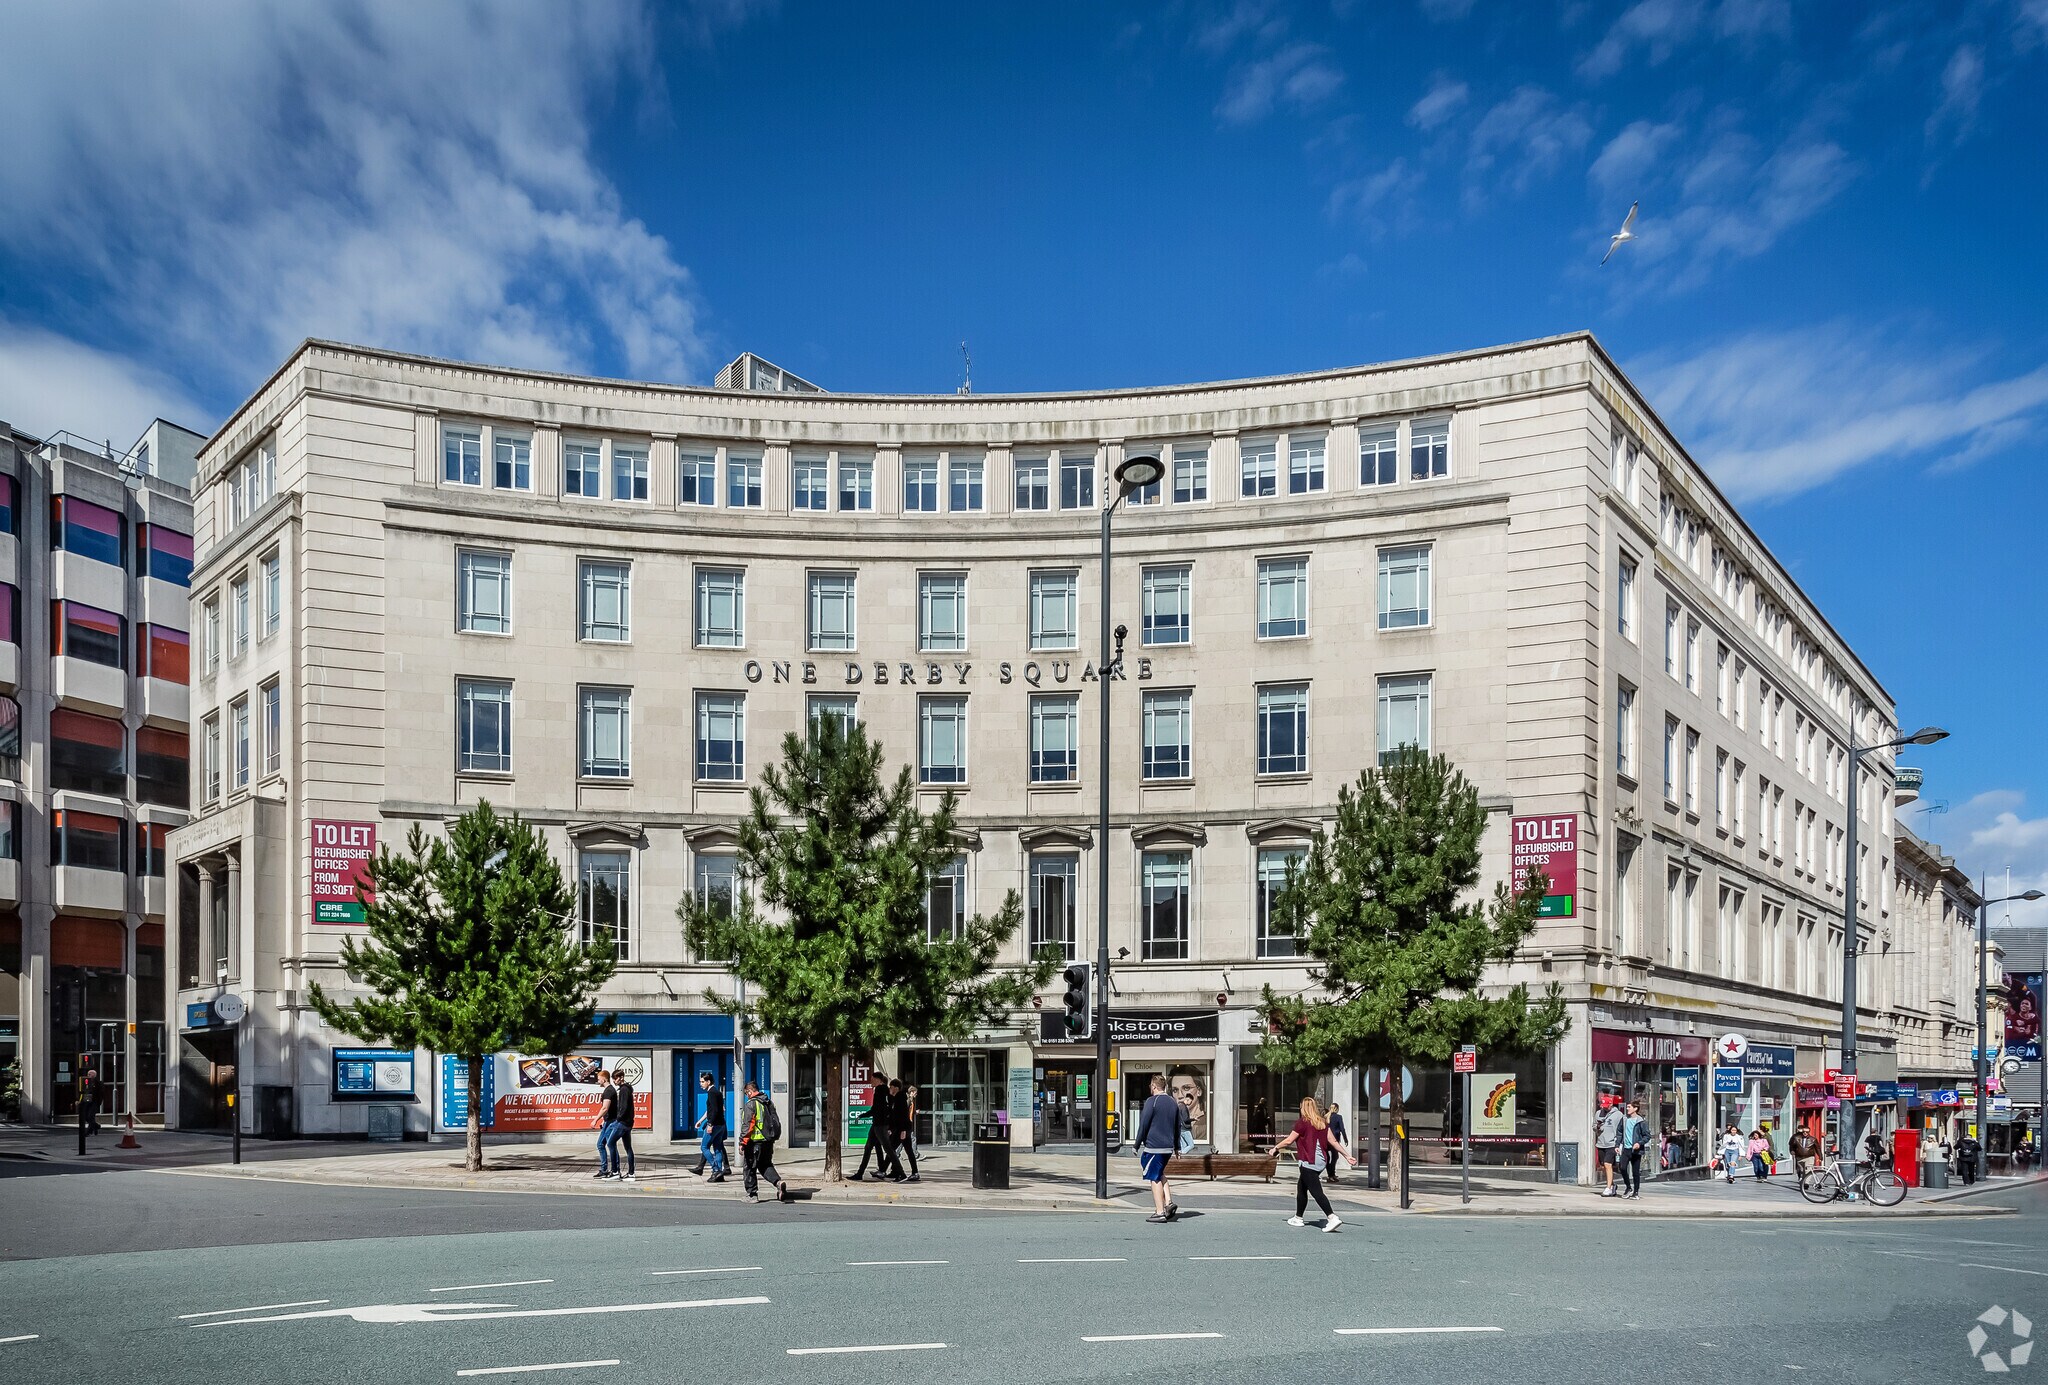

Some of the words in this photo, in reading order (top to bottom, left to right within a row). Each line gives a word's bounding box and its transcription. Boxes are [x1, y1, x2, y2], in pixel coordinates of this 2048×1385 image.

[744, 660, 817, 683] ONE
[845, 661, 971, 684] DERBY
[1000, 657, 1152, 688] SQUARE
[315, 824, 338, 845] TO
[341, 826, 371, 846] LET
[1515, 821, 1538, 841] TO
[1541, 819, 1572, 839] LET
[314, 847, 372, 859] REFURBISHED
[1515, 842, 1574, 854] REFURBISHED
[314, 859, 349, 870] OFFICES
[1515, 855, 1550, 866] OFFICES
[314, 872, 339, 883] FROM
[314, 884, 331, 894] 350
[332, 885, 354, 895] SQFT
[617, 1024, 639, 1033] RUBY
[1091, 1020, 1185, 1031] ankstone
[1111, 1033, 1160, 1041] opticians
[850, 1067, 869, 1081] LET
[535, 1094, 572, 1104] MOVING
[575, 1093, 586, 1103] TO
[588, 1093, 602, 1103] DU
[632, 1092, 648, 1102] EET
